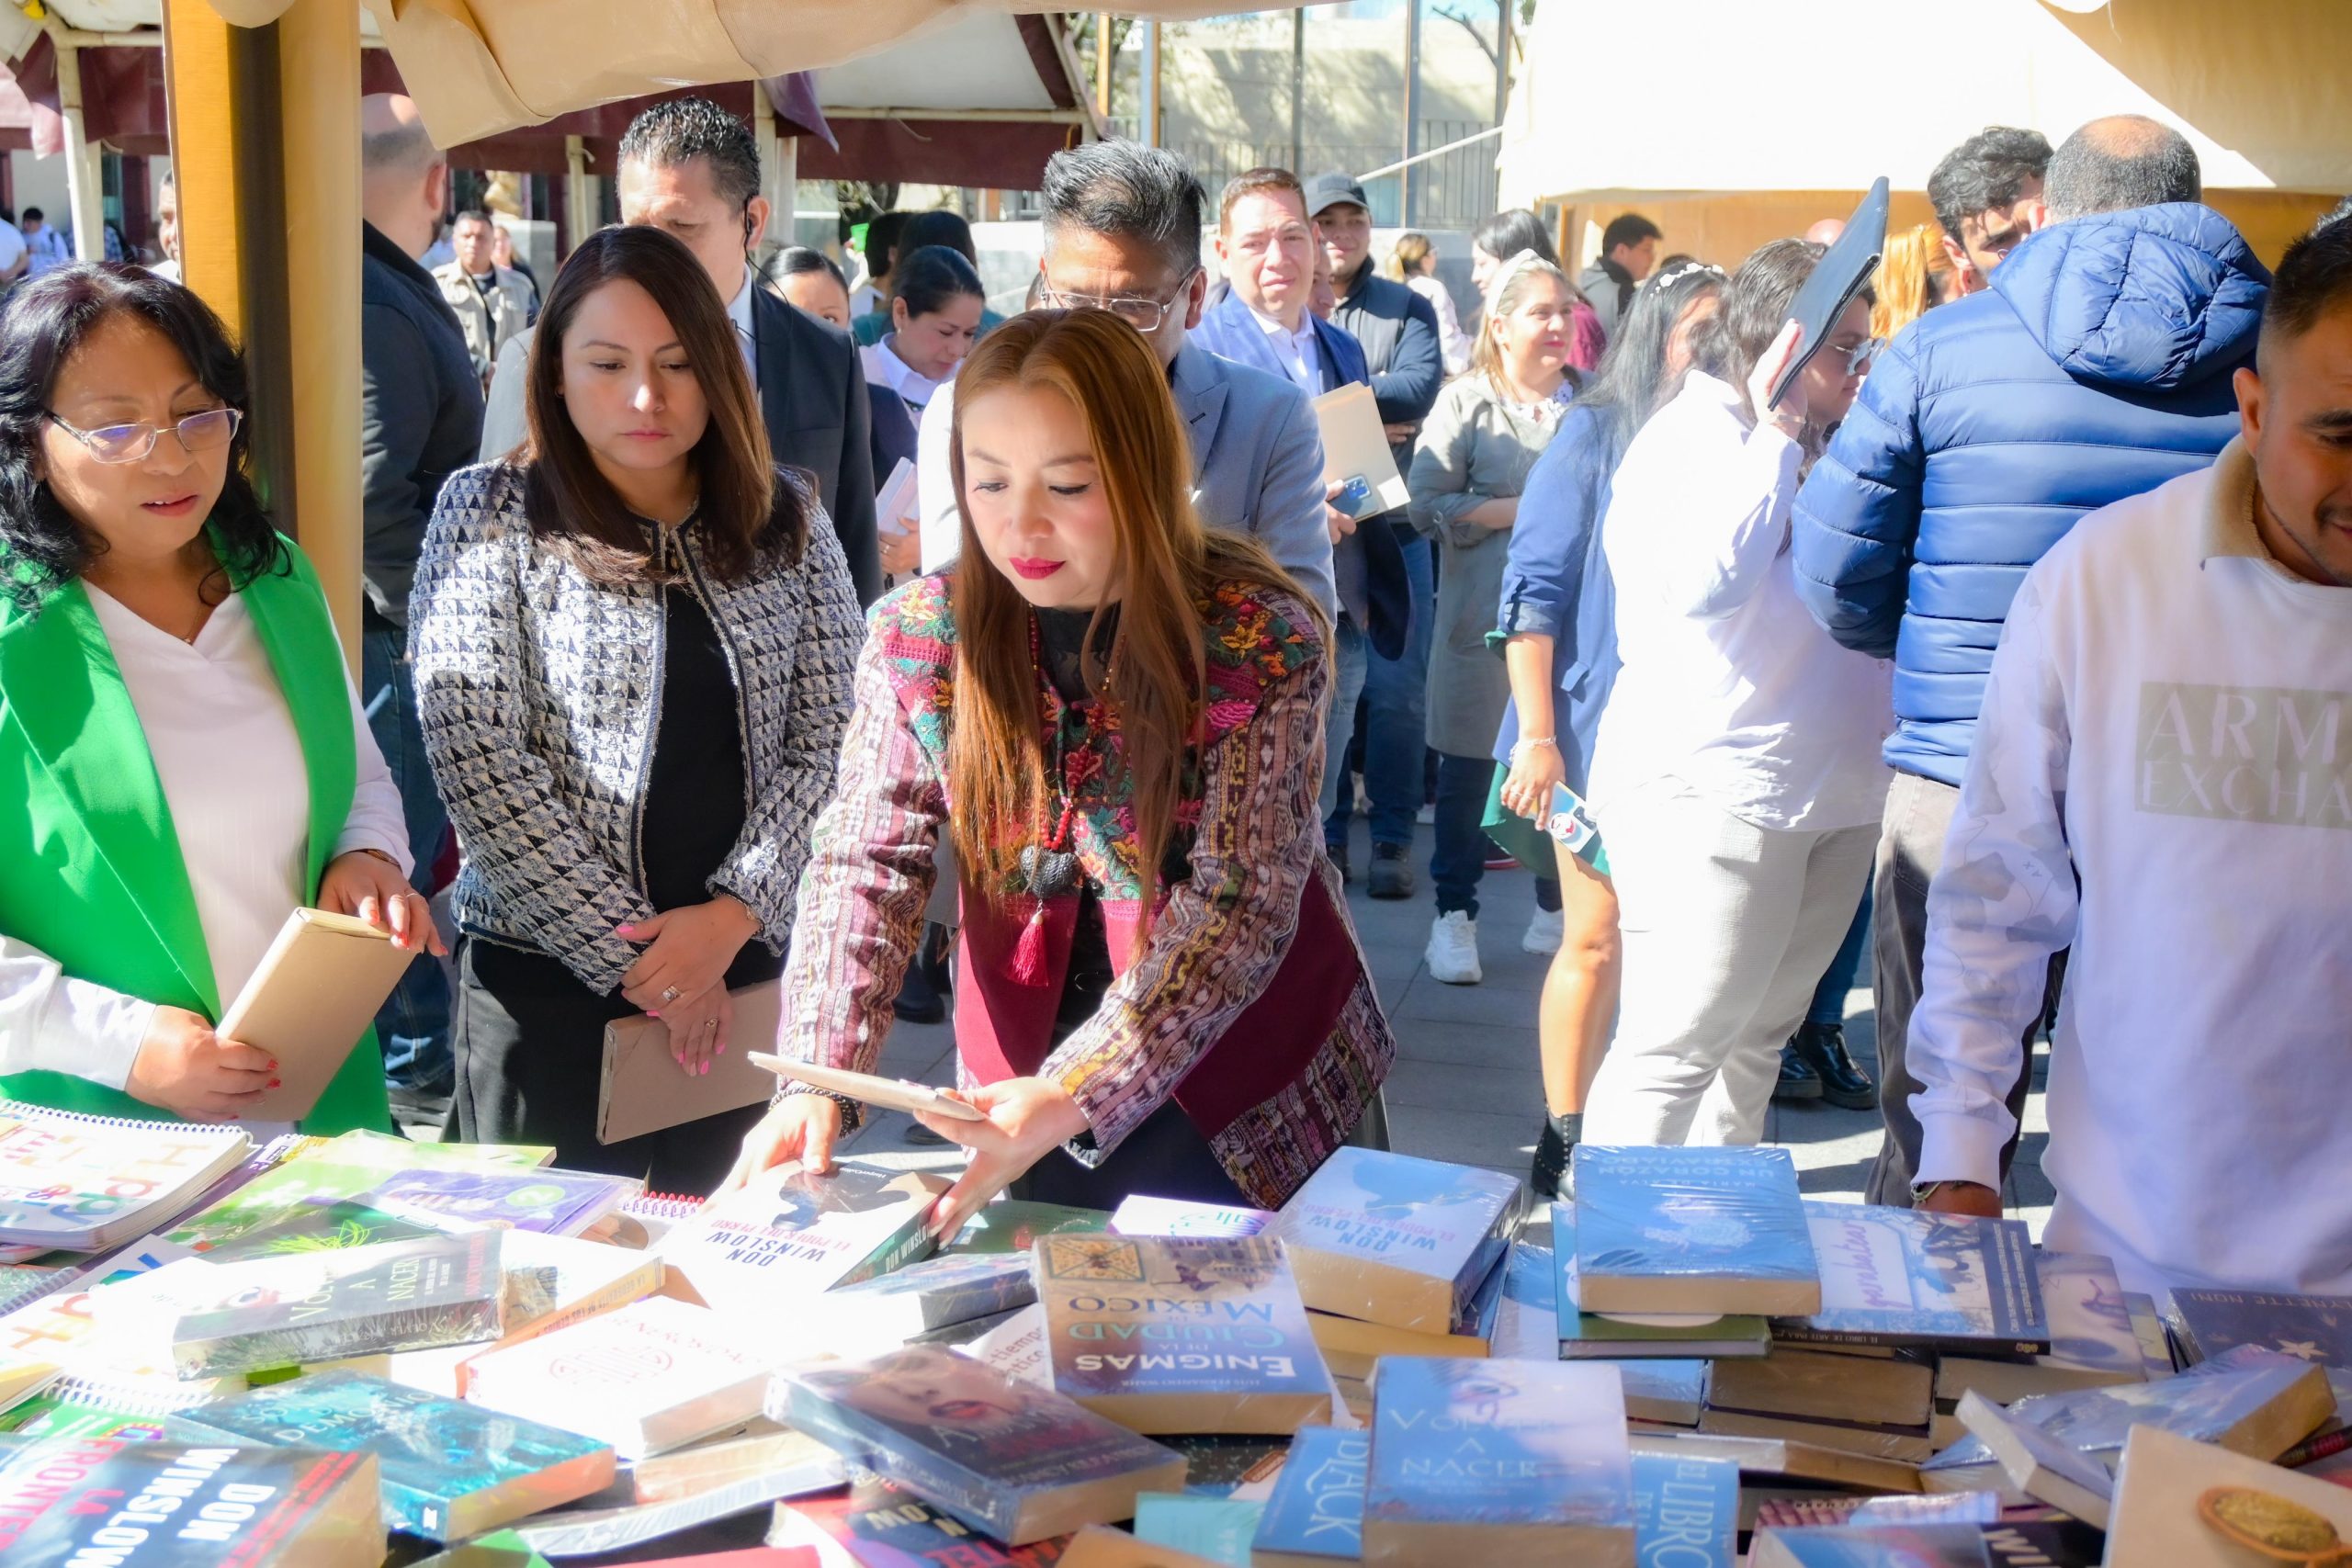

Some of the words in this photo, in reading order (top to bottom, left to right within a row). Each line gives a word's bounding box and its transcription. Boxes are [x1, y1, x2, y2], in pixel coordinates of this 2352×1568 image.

[1306, 1214, 1437, 1251] WINSLOW
[1337, 1232, 1391, 1252] DON
[705, 1231, 827, 1262] WINSLOW
[725, 1248, 778, 1267] DON
[348, 1278, 378, 1291] A
[1069, 1296, 1275, 1323] MÉXICO
[1068, 1323, 1285, 1348] CIUDAD
[1075, 1354, 1298, 1378] ENIGMAS
[1388, 1409, 1555, 1433] VOLVER
[1456, 1438, 1486, 1454] A
[1401, 1458, 1539, 1478] NACER
[70, 1488, 126, 1516] LA
[177, 1483, 277, 1540] DON
